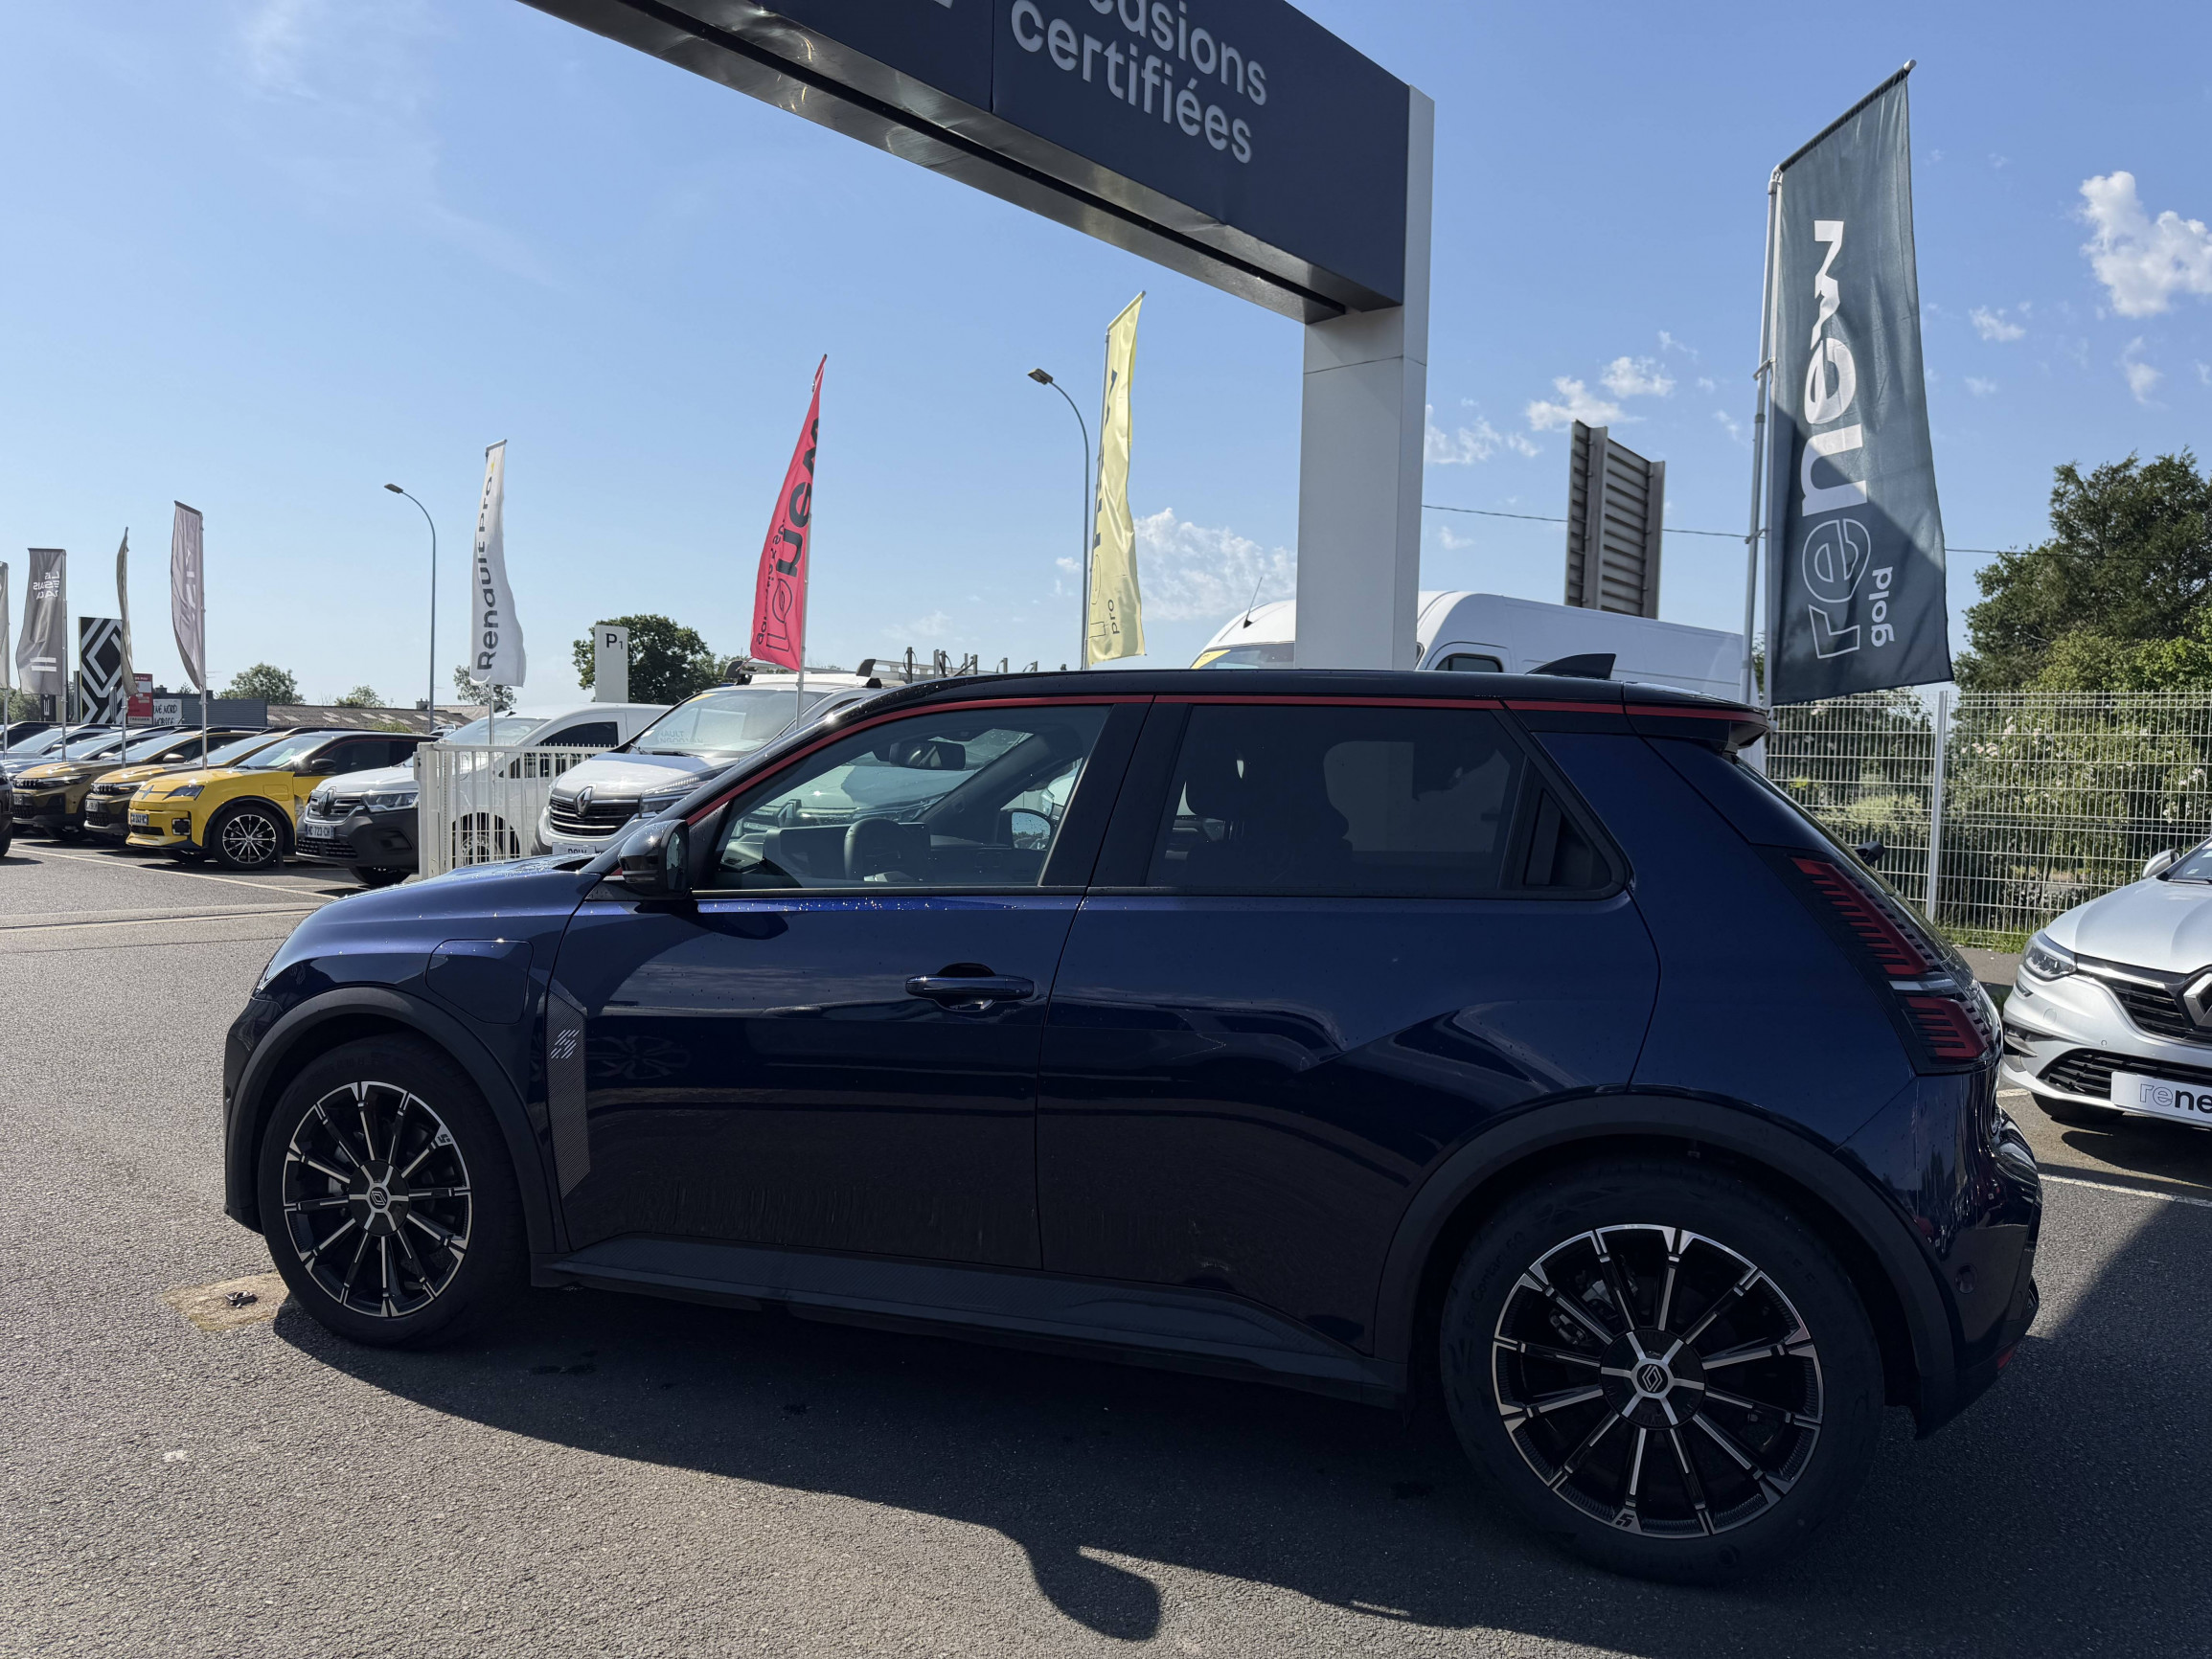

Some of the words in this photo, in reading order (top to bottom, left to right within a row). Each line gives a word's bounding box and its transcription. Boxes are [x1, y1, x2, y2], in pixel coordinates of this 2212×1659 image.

[1011, 0, 1252, 164] certifiées
[1800, 219, 1872, 659] renew
[1107, 599, 1120, 635] pro
[1870, 565, 1894, 648] gold
